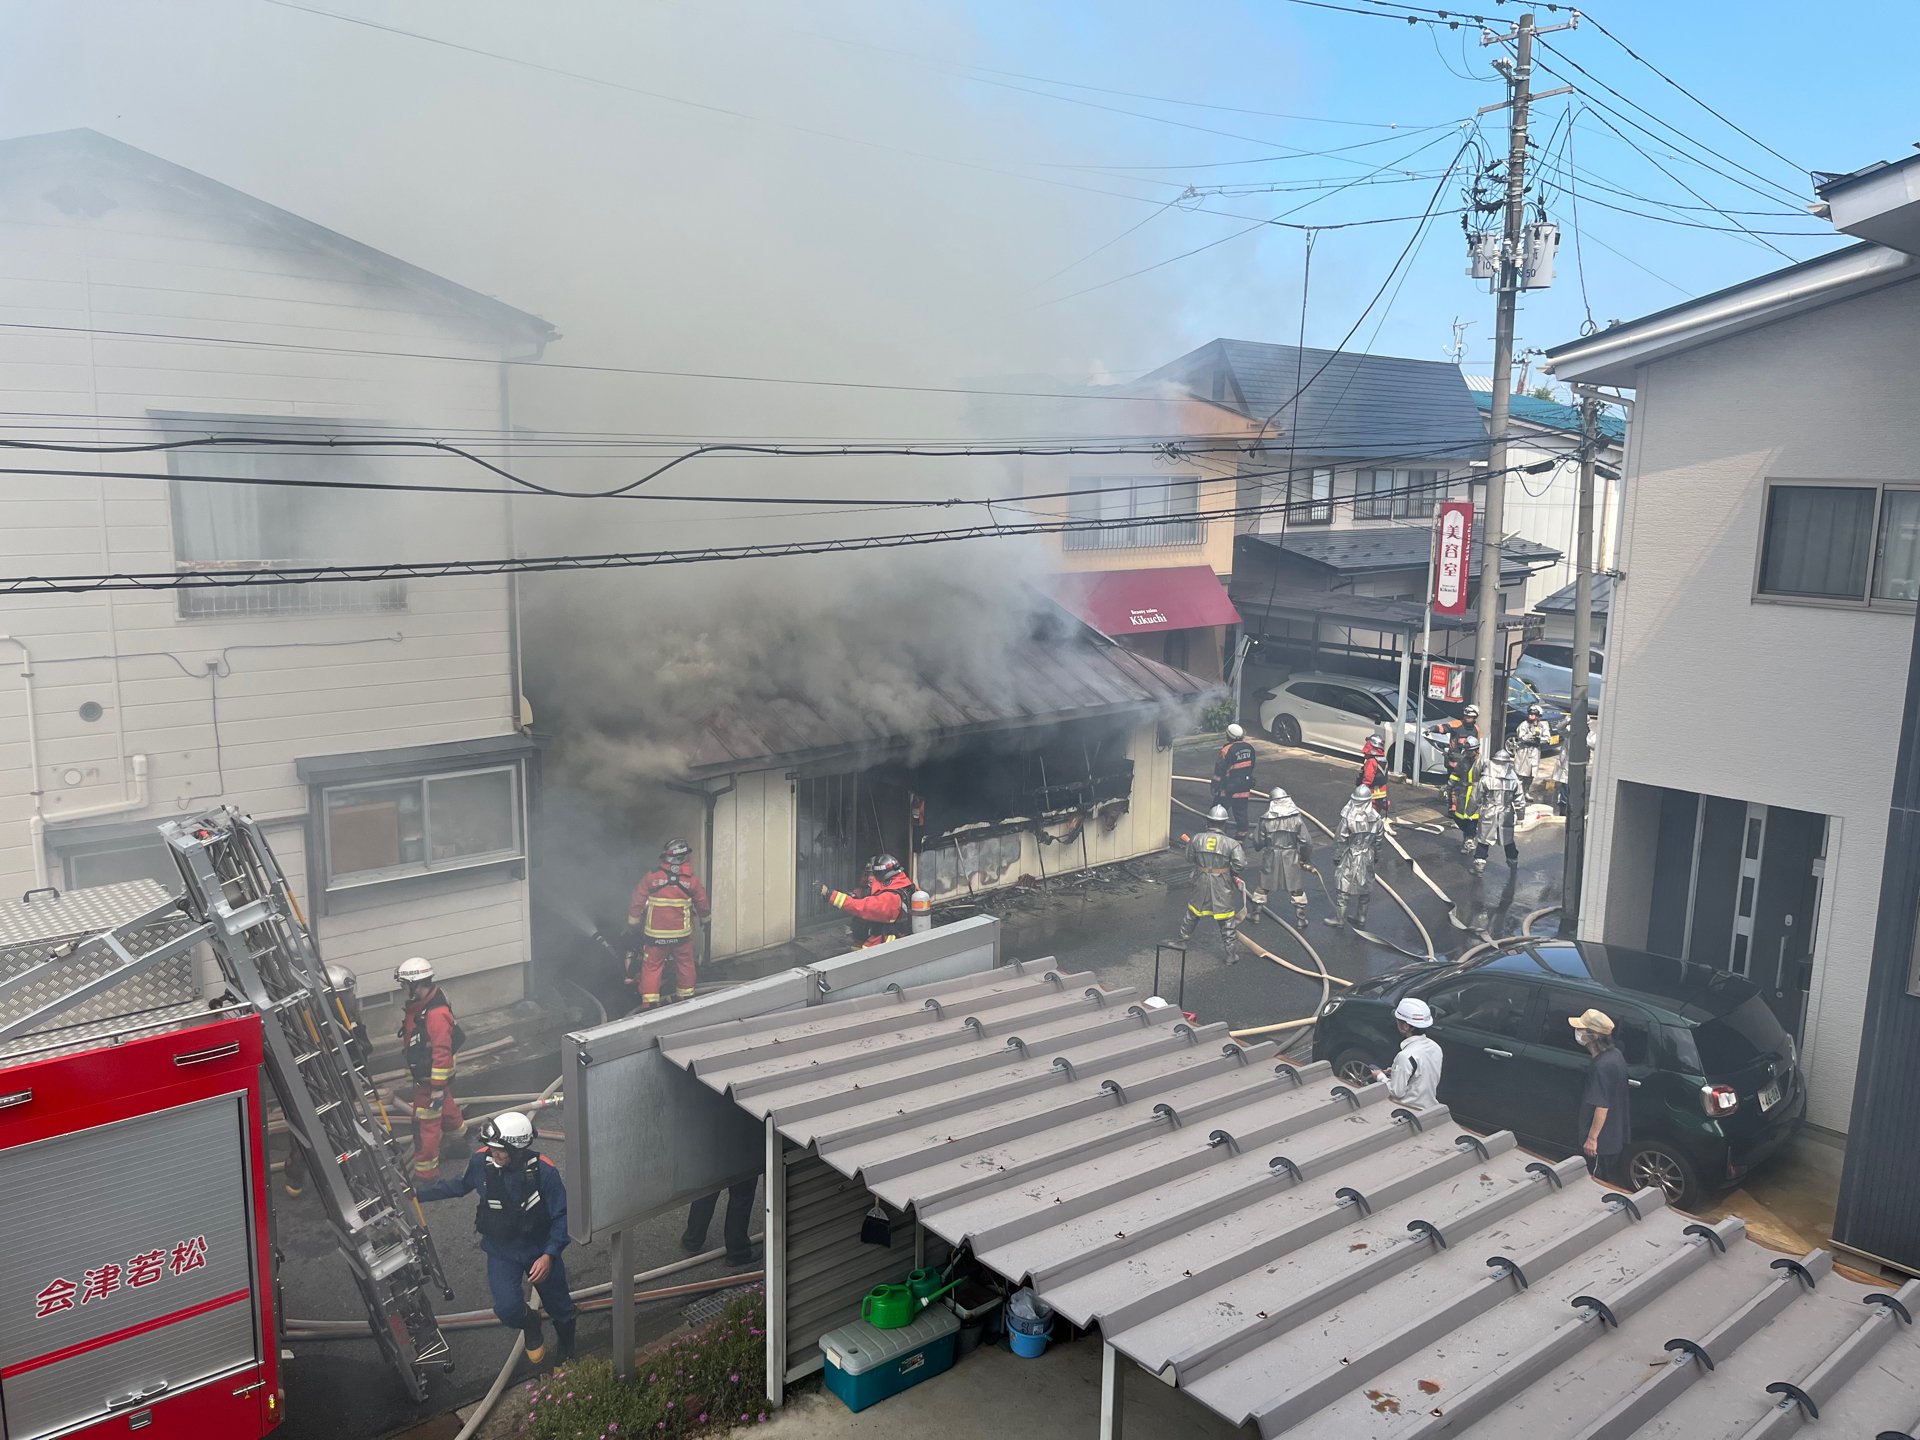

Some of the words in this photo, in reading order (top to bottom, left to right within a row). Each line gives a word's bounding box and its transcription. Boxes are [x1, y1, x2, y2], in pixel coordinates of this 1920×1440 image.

[1482, 261, 1491, 270] 10
[1526, 268, 1536, 278] 50
[1445, 525, 1460, 577] 美容室
[1129, 613, 1167, 625] Kikuchi
[1206, 837, 1217, 852] 2
[36, 1235, 208, 1318] 会津若松
